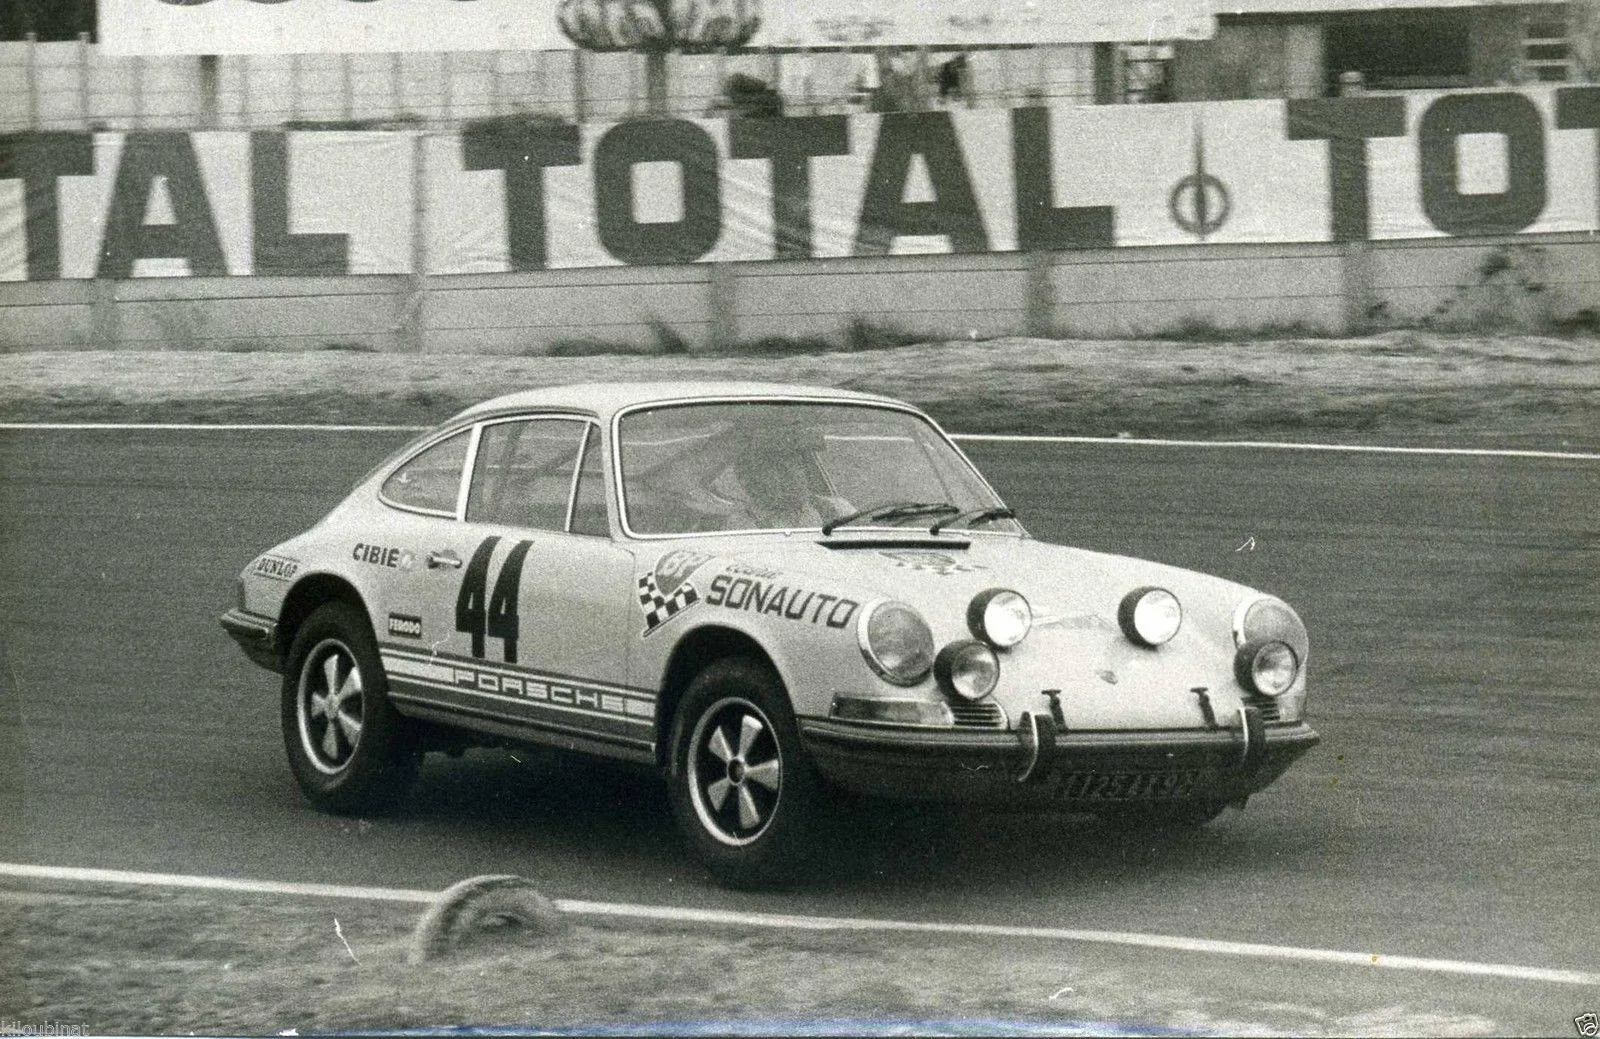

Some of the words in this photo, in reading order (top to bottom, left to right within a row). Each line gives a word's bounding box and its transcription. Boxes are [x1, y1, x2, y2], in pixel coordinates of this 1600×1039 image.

[0, 130, 348, 281] TAL
[462, 107, 1114, 271] TOTAL
[456, 536, 534, 663] 44
[706, 574, 859, 629] SONAUTO
[454, 669, 625, 713] PORSCHE
